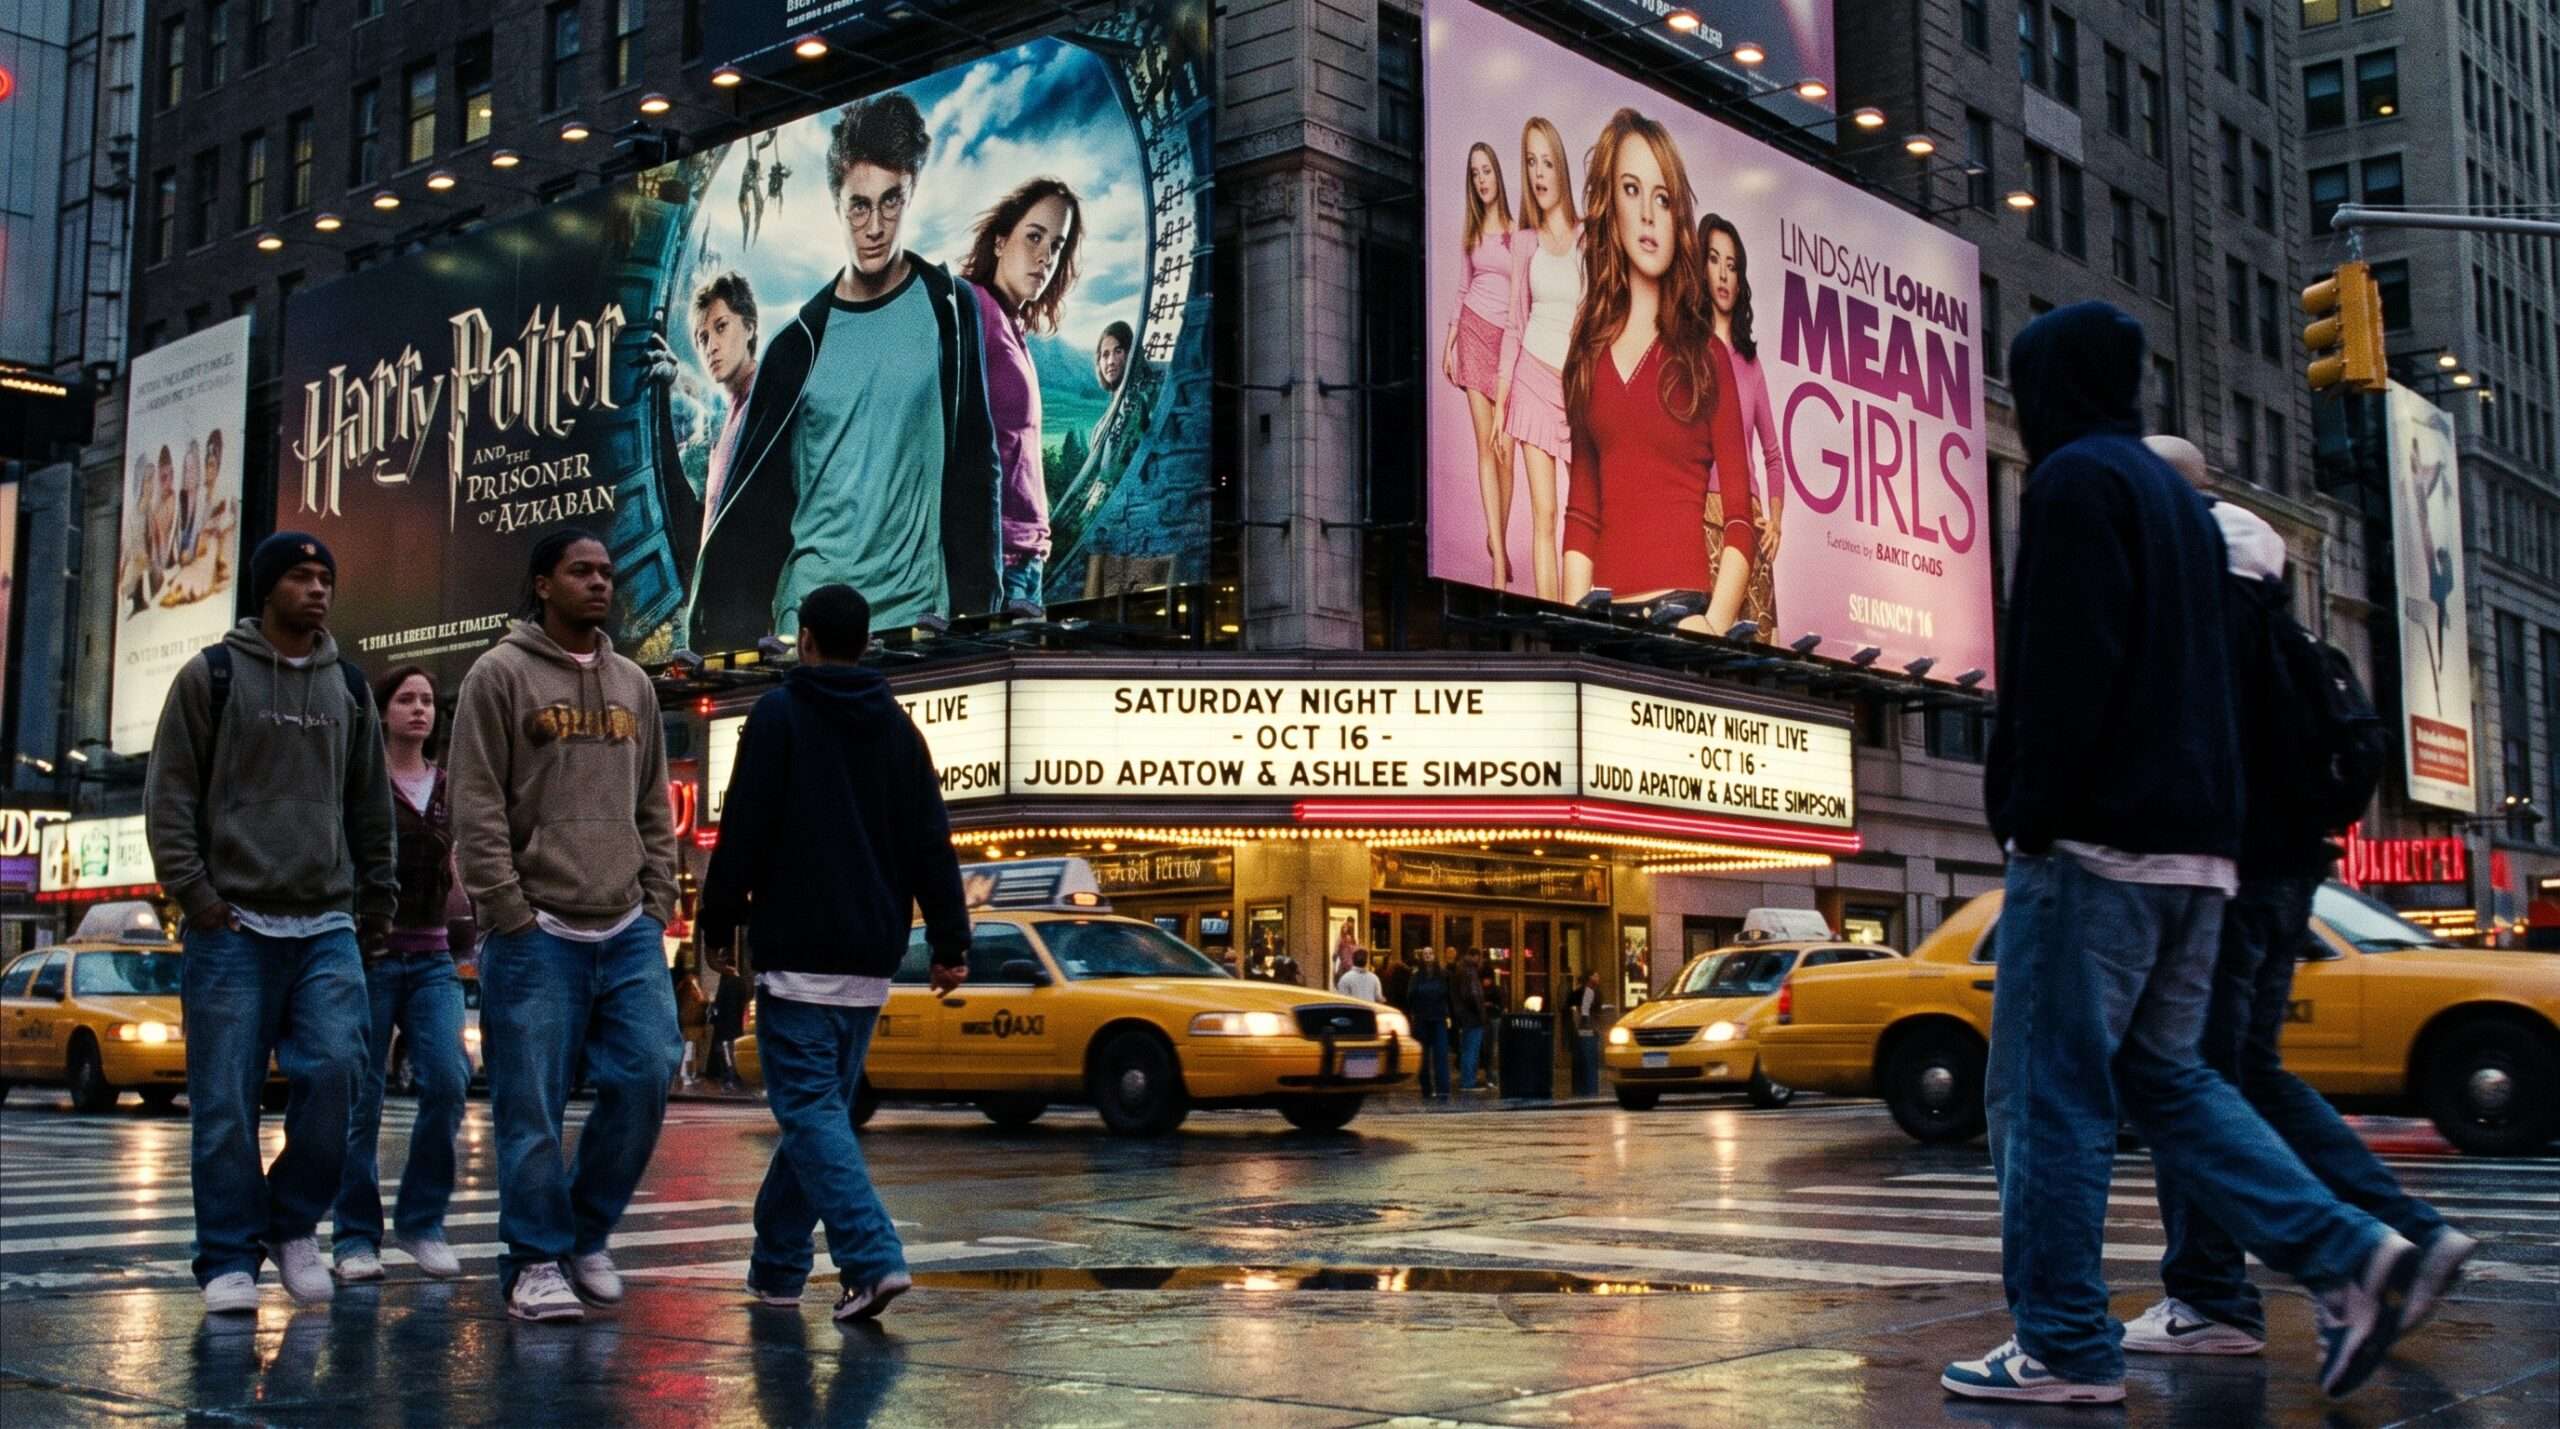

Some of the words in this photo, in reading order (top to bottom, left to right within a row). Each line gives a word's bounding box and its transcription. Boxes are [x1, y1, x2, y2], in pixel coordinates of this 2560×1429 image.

[1780, 218, 1880, 297] LINDSAY
[1883, 266, 1968, 337] LOHAN
[1780, 269, 1972, 430] MEAN
[292, 343, 445, 519] Harry
[448, 302, 626, 533] Potter
[466, 453, 592, 503] PRISONER
[472, 445, 506, 465] AND
[505, 449, 531, 465] THE
[1782, 381, 1976, 554] GIRLS
[478, 510, 497, 524] OF
[496, 485, 617, 534] AZKABAN
[926, 694, 968, 724] LIVE
[1114, 687, 1284, 714] SATURDAY
[1301, 688, 1397, 714] NIGHT
[1415, 688, 1483, 714] LIVE
[1257, 725, 1320, 750] OCT
[1340, 725, 1368, 750] 16
[1631, 700, 1716, 737] SATURDAY
[1724, 716, 1769, 746] NIGHT
[1776, 725, 1808, 752] LIVE
[936, 761, 1001, 791] MPSON
[1024, 760, 1104, 786] JUDD
[1117, 760, 1244, 786] APATOW
[1257, 760, 1277, 786] &
[1289, 761, 1408, 786] ASHLEE
[1423, 761, 1562, 787] SIMPSON
[1701, 746, 1732, 772] OCT
[1740, 752, 1755, 775] 16
[1589, 764, 1633, 792] JUDD
[1638, 770, 1703, 801] APATOW
[1707, 780, 1718, 803] &
[1723, 782, 1779, 811] ASHLEE
[1784, 790, 1846, 818] SIMPSON
